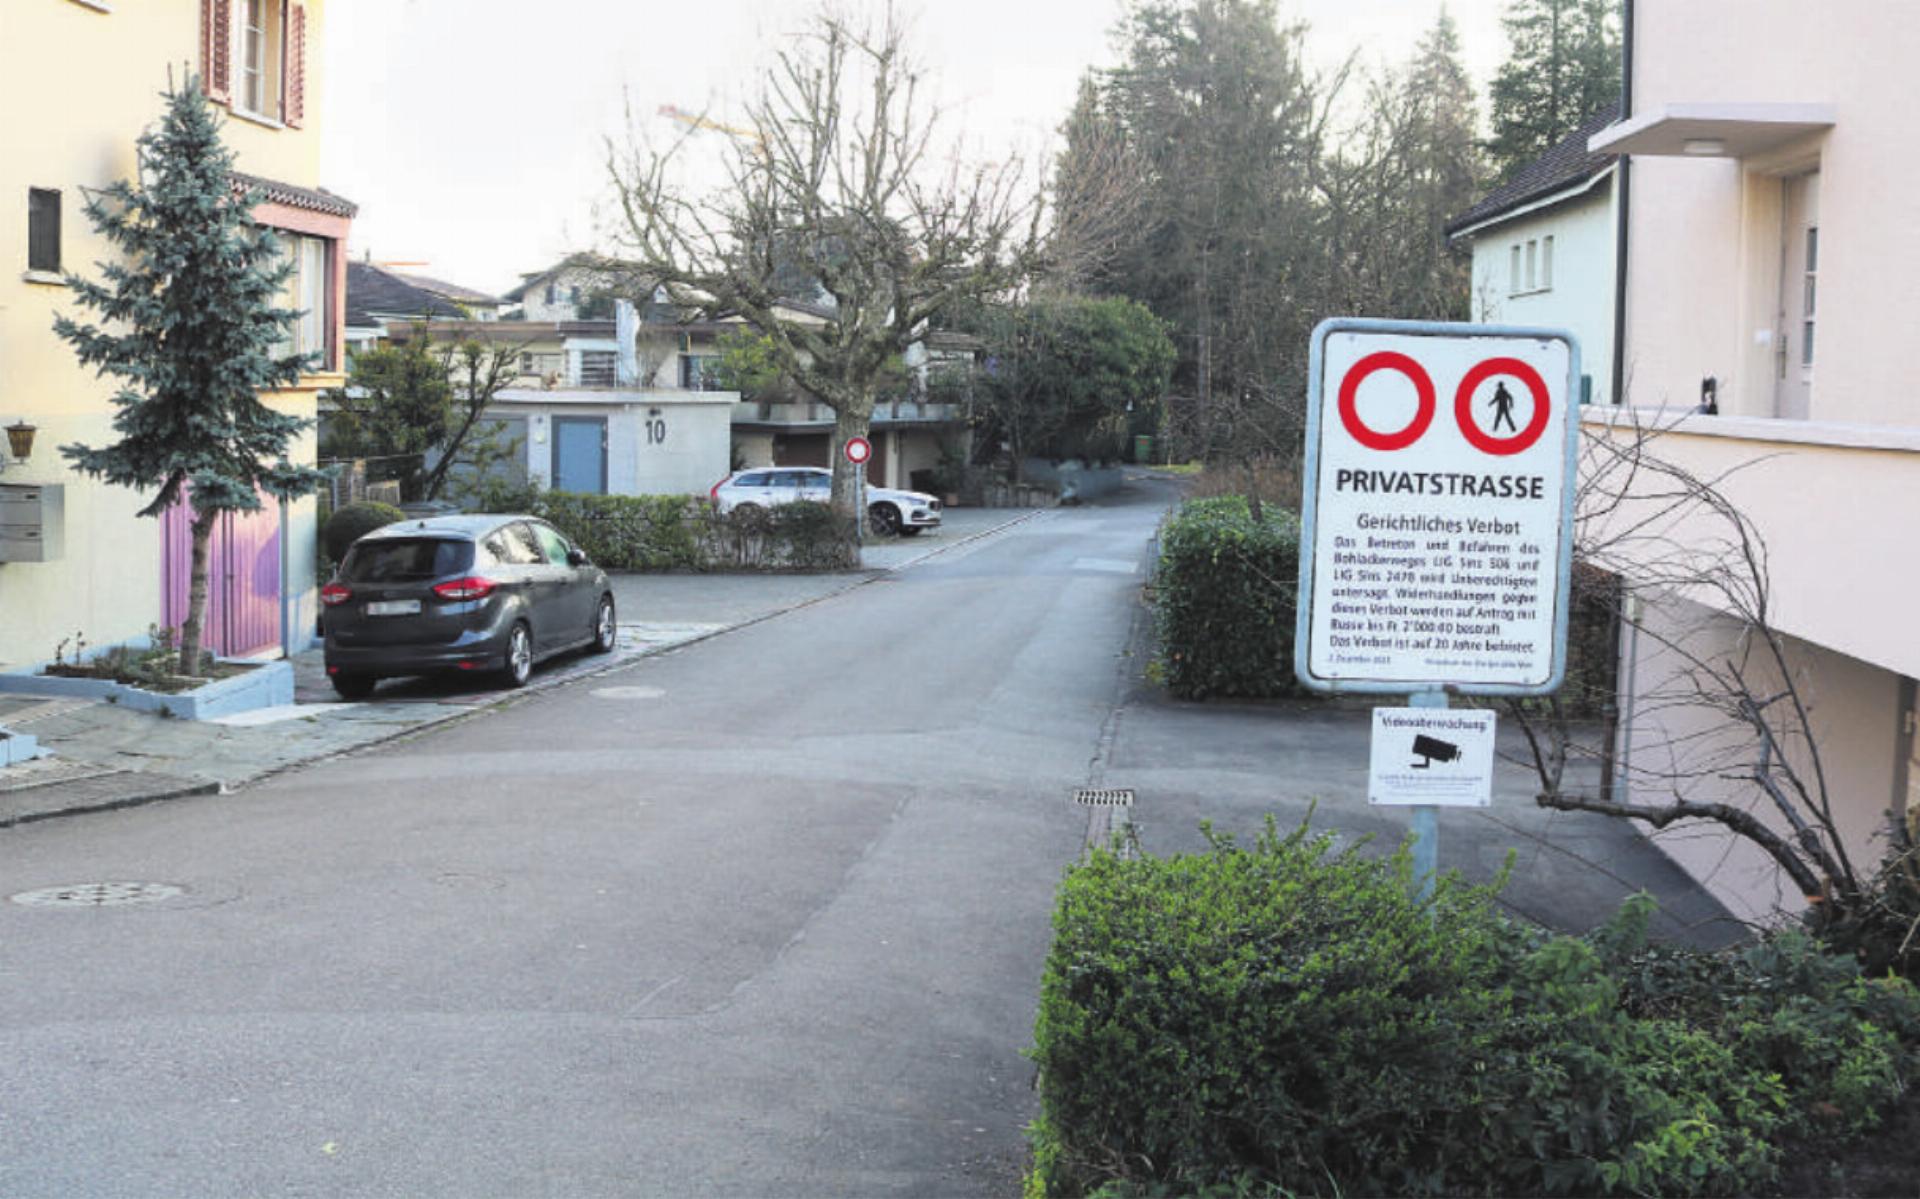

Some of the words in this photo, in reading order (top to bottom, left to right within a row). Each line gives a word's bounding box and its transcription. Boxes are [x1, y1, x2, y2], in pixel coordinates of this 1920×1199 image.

[645, 419, 666, 445] 10
[1336, 469, 1544, 499] PRIVATSTRASSE
[1357, 513, 1463, 533] Gerichtliches
[1467, 518, 1521, 535] Verbot
[1334, 536, 1356, 548] Das
[1426, 539, 1449, 550] und
[1519, 543, 1540, 554] des
[1517, 559, 1540, 571] und
[1420, 573, 1445, 584] wird
[1395, 588, 1496, 603] Widerhandlungen
[1502, 593, 1537, 606] gegen
[1331, 601, 1367, 614] dieses
[1369, 603, 1408, 616] Verbot
[1410, 606, 1453, 618] werden
[1456, 606, 1475, 618] auf
[1476, 608, 1514, 622] Antrag
[1517, 609, 1536, 620] mit
[1331, 618, 1364, 631] Busse
[1367, 619, 1383, 631] bis
[1330, 635, 1350, 647] Das
[1353, 635, 1392, 648] Verbot
[1395, 637, 1409, 649] ist
[1411, 637, 1432, 649] auf
[1435, 638, 1449, 649] 20
[1452, 639, 1482, 651] Jahre
